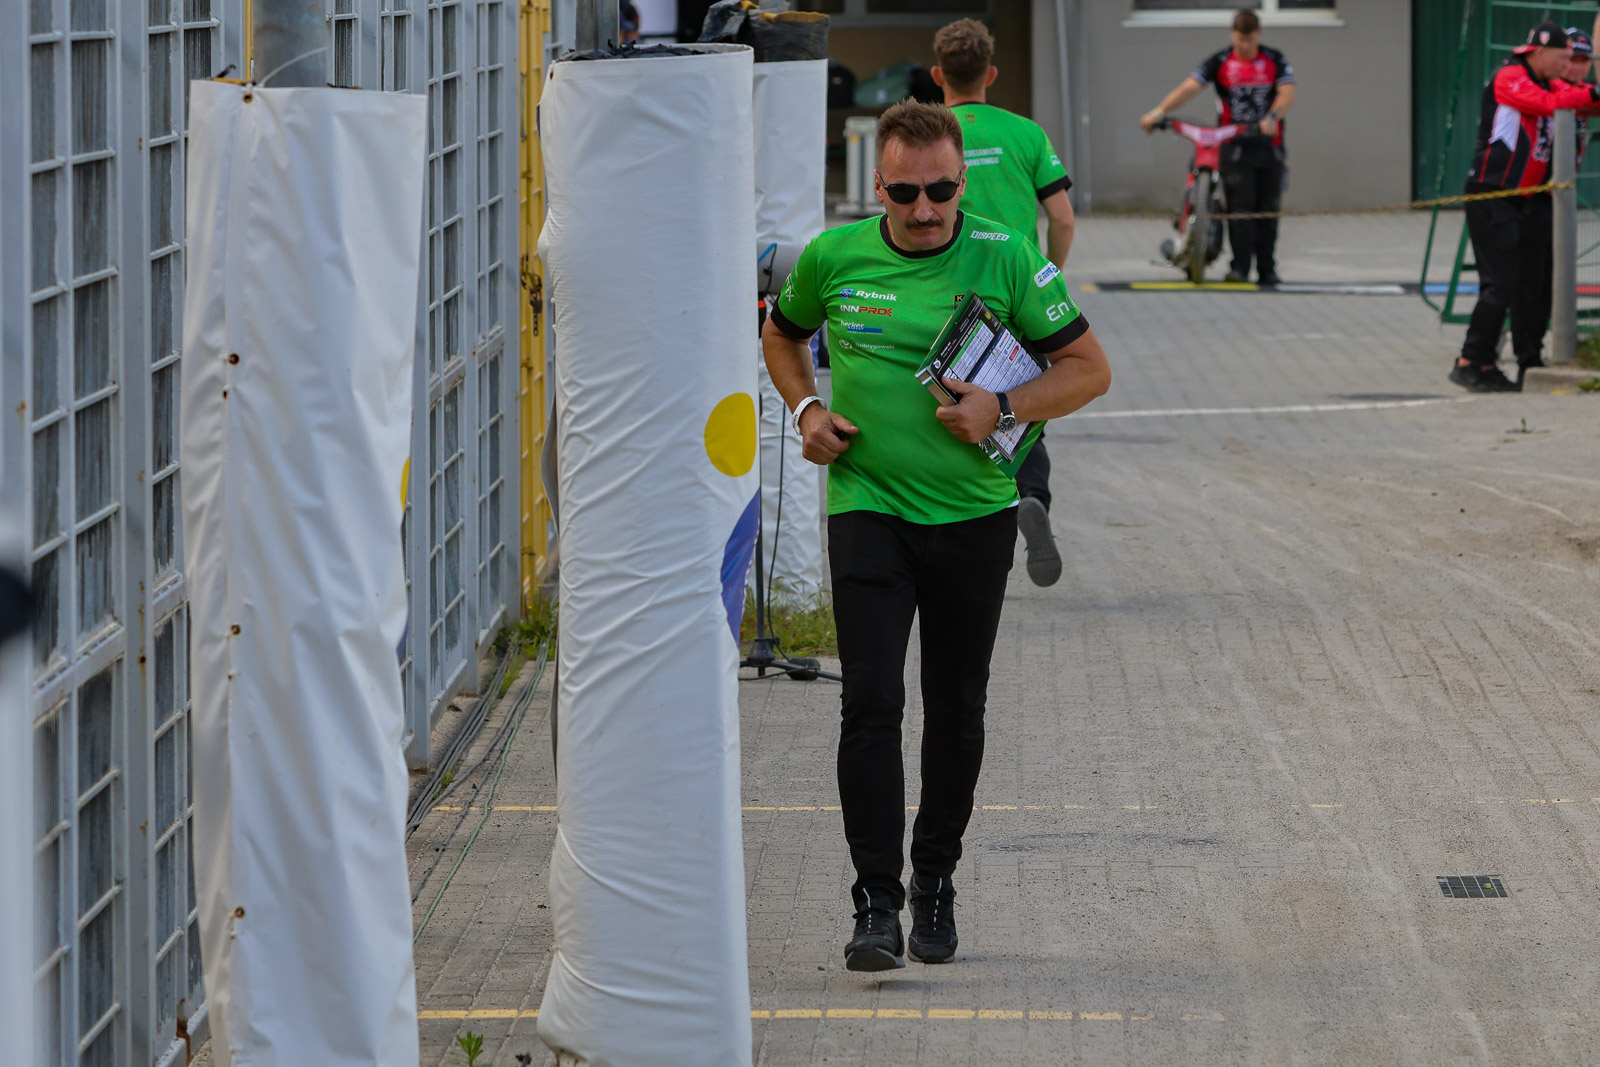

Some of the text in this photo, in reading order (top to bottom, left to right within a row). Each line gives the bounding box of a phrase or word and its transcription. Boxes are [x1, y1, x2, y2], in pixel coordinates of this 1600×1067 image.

[970, 230, 1010, 242] DISPEED
[855, 290, 897, 301] Rybnik
[840, 304, 890, 316] INNPRO
